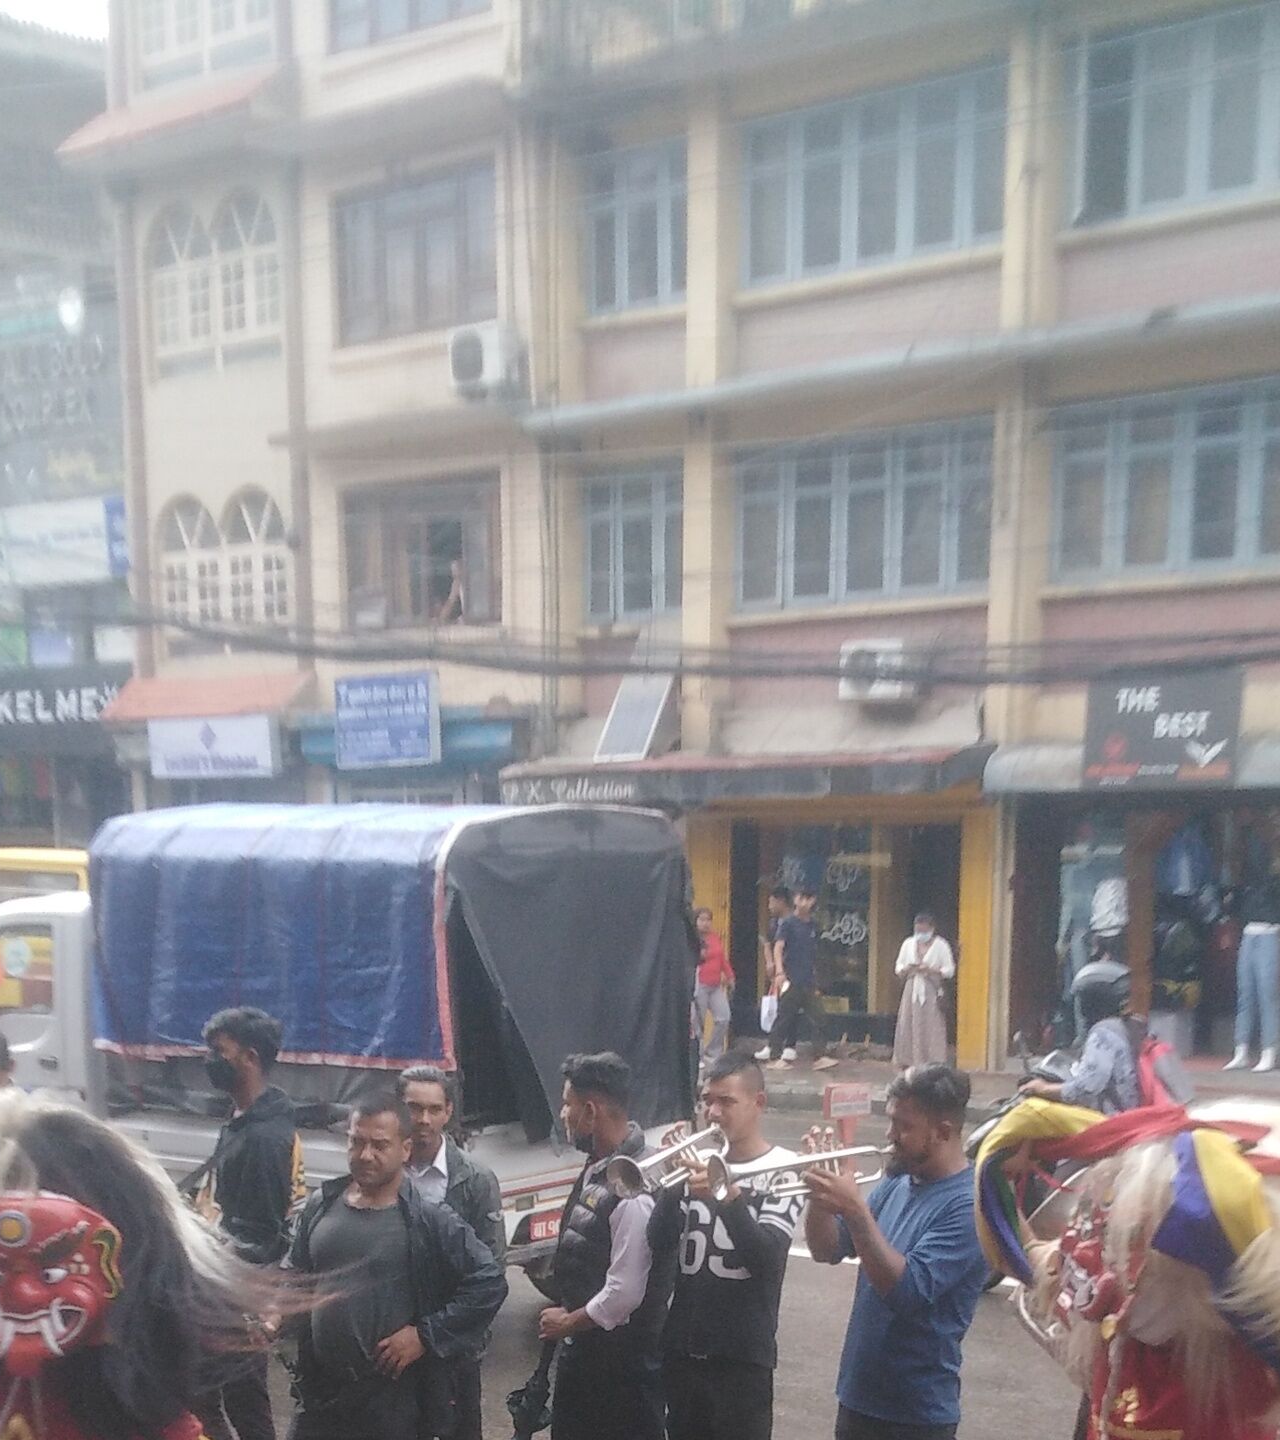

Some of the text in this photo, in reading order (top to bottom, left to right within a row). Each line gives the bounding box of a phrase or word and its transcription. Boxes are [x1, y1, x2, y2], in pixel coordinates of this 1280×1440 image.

[1115, 686, 1161, 714] THE
[1153, 710, 1211, 738] BEST
[550, 777, 637, 801] Collection
